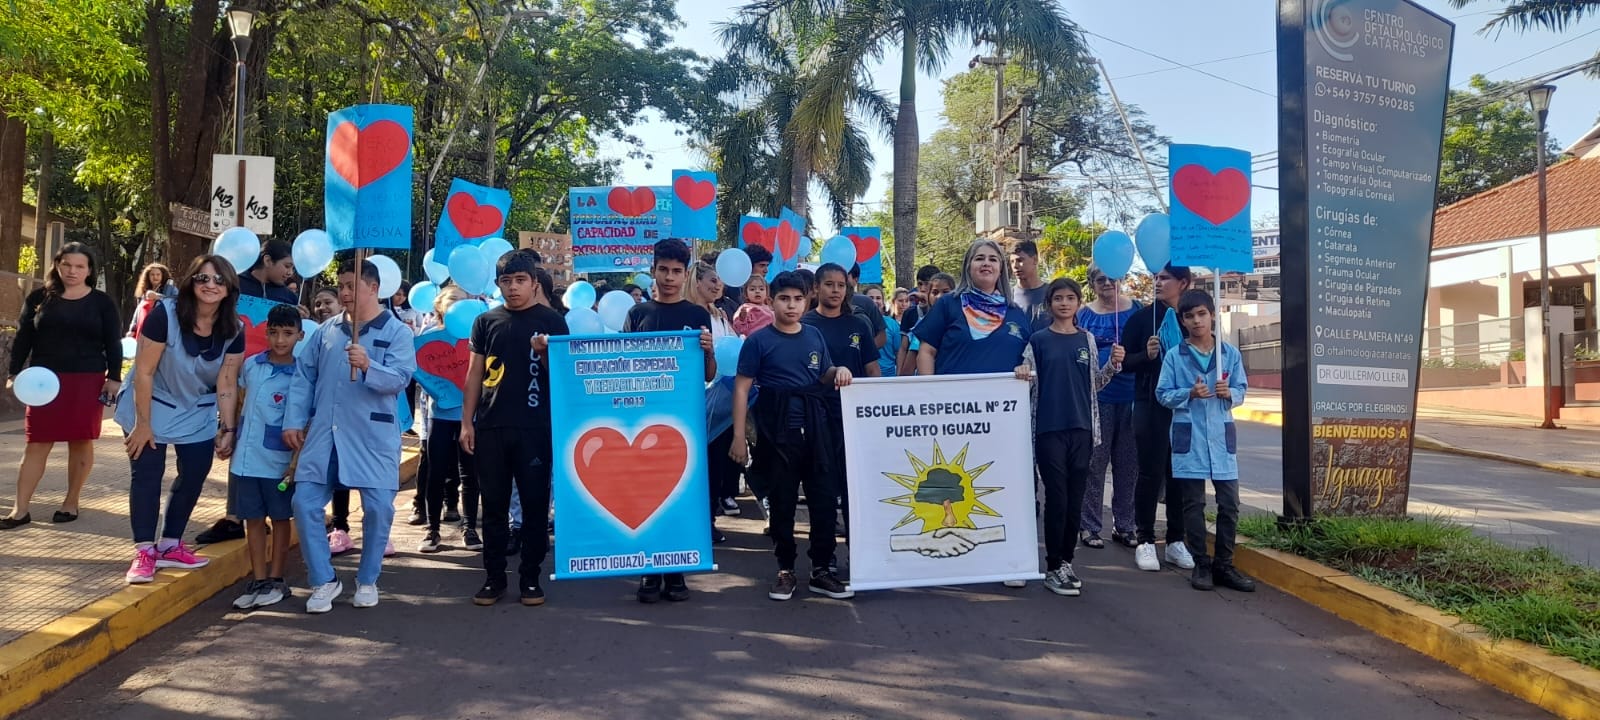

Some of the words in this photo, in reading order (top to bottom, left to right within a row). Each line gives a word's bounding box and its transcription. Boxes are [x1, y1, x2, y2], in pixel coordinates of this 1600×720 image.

[1364, 9, 1404, 27] CENTRO
[1364, 21, 1444, 50] OFTALMOLÓGICO
[1364, 34, 1426, 58] CATARATAS
[1315, 66, 1363, 85] RESERVA
[1365, 75, 1379, 88] TU
[1381, 78, 1416, 95] TURNO
[1353, 90, 1377, 105] 3757
[1378, 95, 1415, 112] 590285
[1313, 109, 1378, 133] Diagnóstico:
[1361, 150, 1386, 163] Ocular
[1322, 157, 1350, 170] Campo
[1352, 162, 1375, 174] Visual
[1377, 165, 1432, 182] Computarizado
[1368, 175, 1392, 188] Óptica
[577, 196, 597, 207] LA
[1365, 189, 1395, 201] Corneal
[1316, 206, 1360, 225] Cirugías
[1363, 213, 1378, 226] de:
[577, 226, 636, 239] CAPACIDAD
[644, 229, 659, 238] DE
[1324, 226, 1352, 239] Córnea
[1324, 240, 1357, 252] Catarata
[1324, 253, 1363, 266] Segmento
[1365, 257, 1396, 270] Anterior
[1325, 266, 1353, 278] Trauma
[1355, 268, 1380, 281] Ocular
[1354, 282, 1363, 292] de
[1365, 282, 1401, 296] Párpados
[1354, 295, 1363, 305] de
[1366, 296, 1390, 307] Retina
[1324, 328, 1351, 339] CALLE
[1353, 330, 1392, 343] PALMERA
[569, 339, 622, 355] INSTITUTO
[623, 336, 684, 353] ESPERANZA
[575, 356, 631, 375] EDUCACIÓN
[632, 356, 679, 374] ESPECIAL
[584, 379, 594, 394] Y
[593, 374, 674, 394] REHABILITACIÓN
[1320, 369, 1331, 379] DR
[1333, 369, 1381, 382] GUILLERMO
[1383, 372, 1407, 383] LLERA
[856, 404, 916, 418] ESCUELA
[920, 402, 982, 415] ESPECIAL
[1003, 400, 1018, 412] 27
[1313, 401, 1347, 413] ¡GRACIAS
[1349, 403, 1362, 412] POR
[1366, 403, 1408, 414] ELEGIRNOS!
[886, 424, 938, 438] PUERTO
[942, 422, 991, 435] IGUAZU
[1312, 425, 1395, 439] BIENVENIDOS
[1399, 427, 1408, 439] A
[1321, 444, 1397, 508] Iguazú
[570, 558, 608, 573] PUERTO
[609, 551, 645, 571] IGUAZÚ
[653, 551, 700, 567] MISIONES
